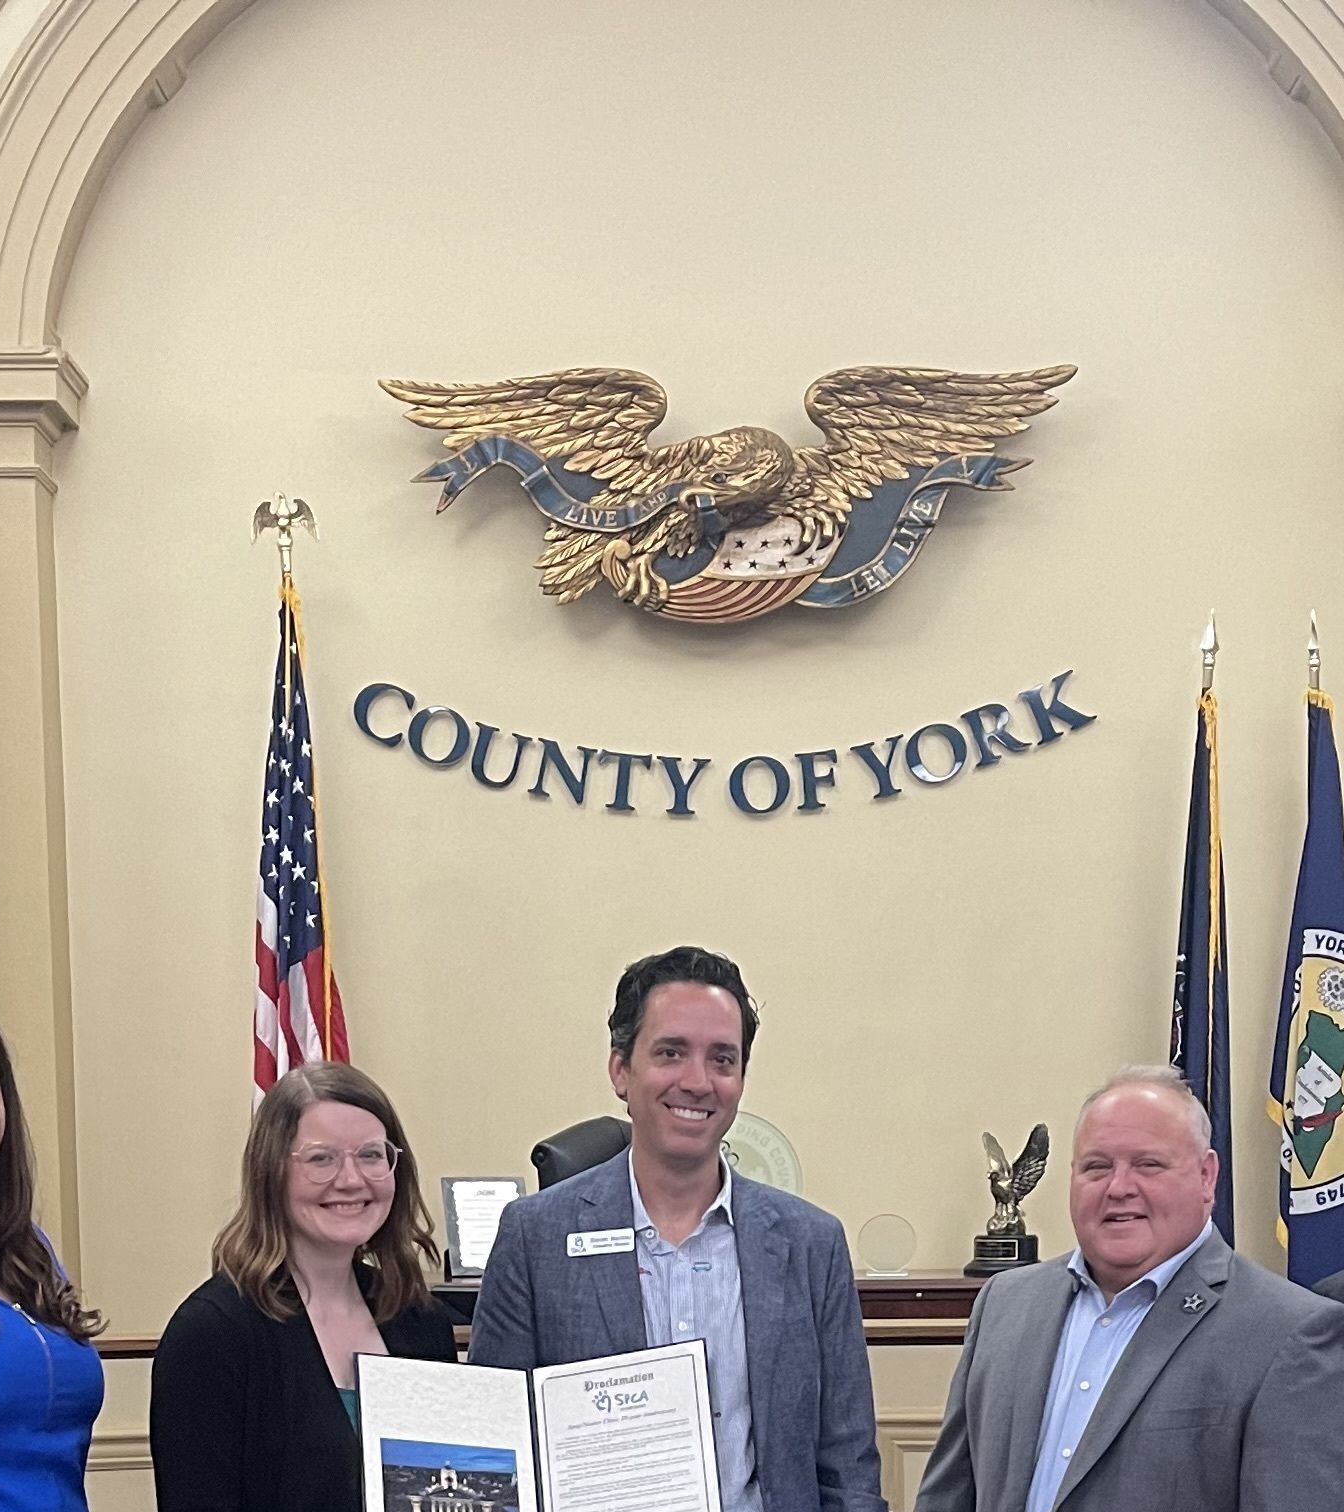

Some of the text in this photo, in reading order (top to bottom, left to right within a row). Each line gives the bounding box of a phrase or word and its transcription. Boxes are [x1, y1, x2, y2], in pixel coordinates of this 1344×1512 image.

[564, 491, 933, 597] LIVE AND LET LIVE
[352, 668, 1099, 816] COUNTY OF YORK
[584, 1371, 655, 1392] Proclamation
[614, 1390, 649, 1407] SPCA
